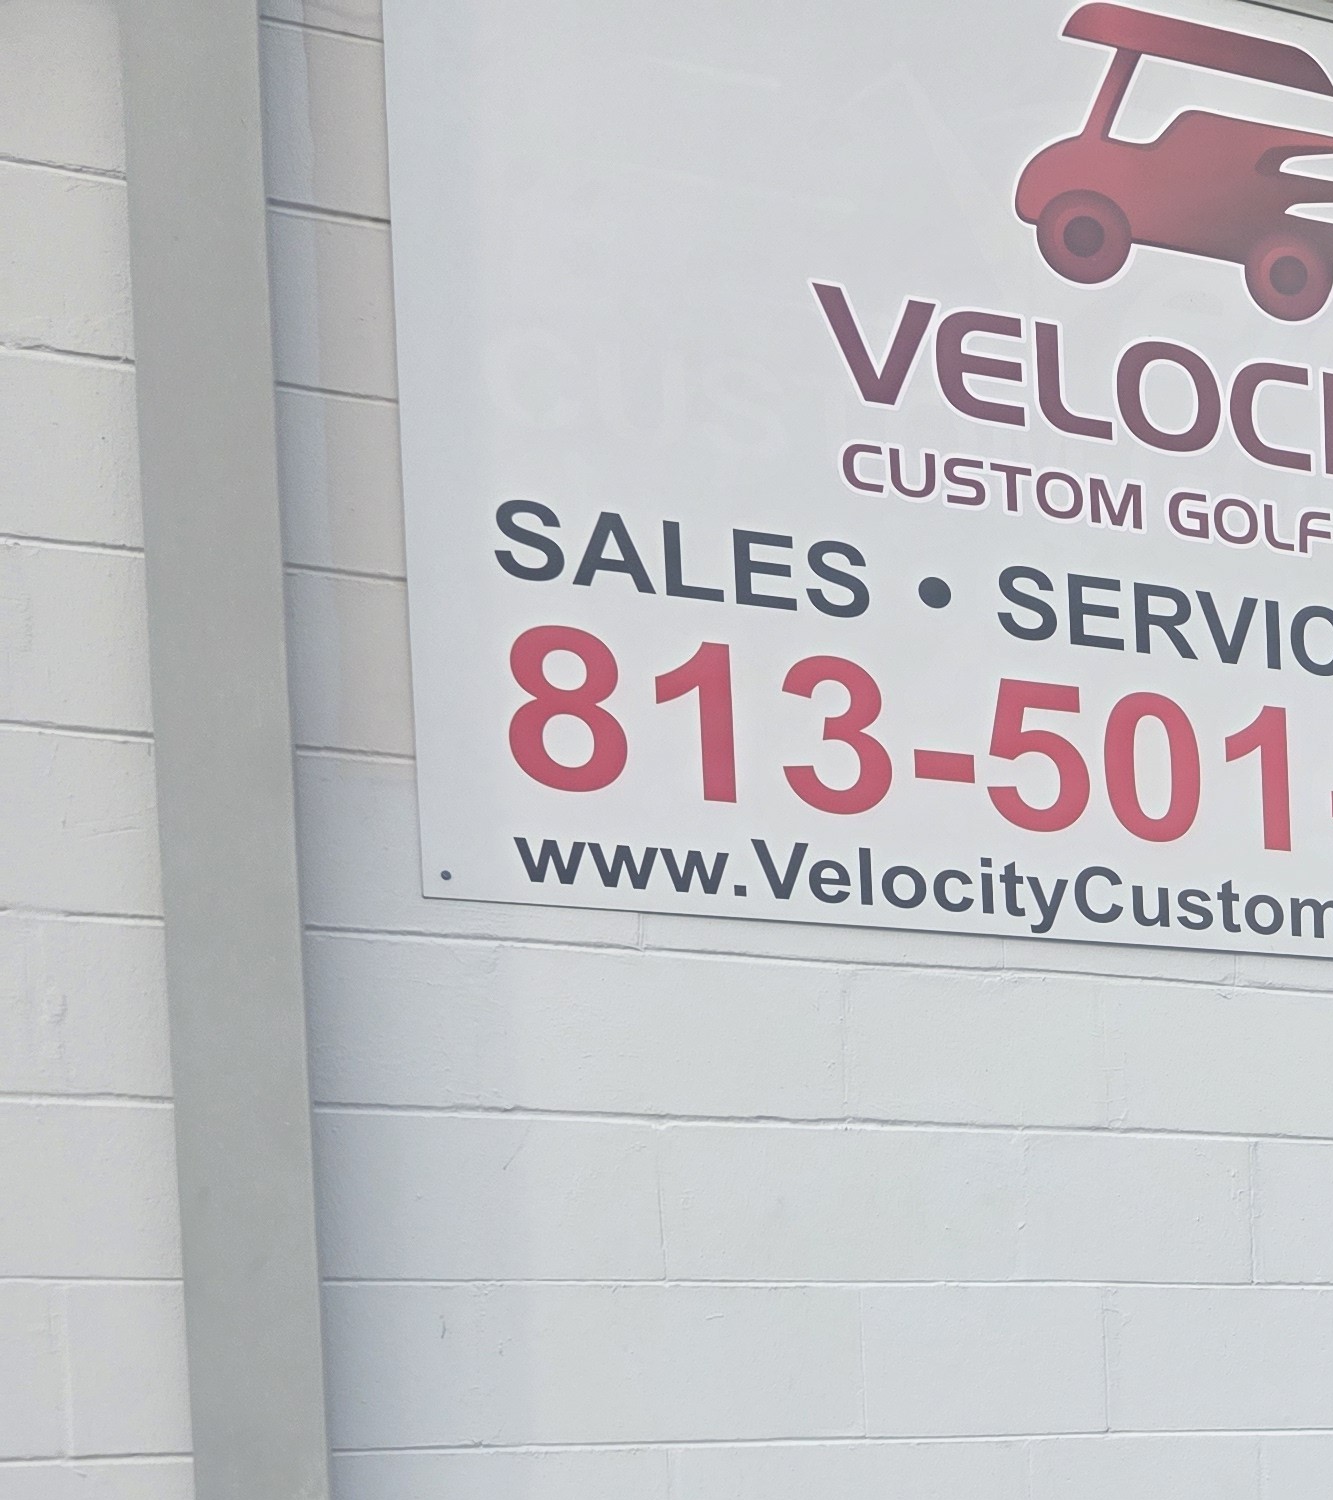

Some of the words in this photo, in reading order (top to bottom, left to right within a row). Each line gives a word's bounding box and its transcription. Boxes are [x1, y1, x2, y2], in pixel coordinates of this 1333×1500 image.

[842, 443, 1143, 530] CUSTOM
[1168, 491, 1332, 554] GOLF
[494, 499, 870, 619] SALES
